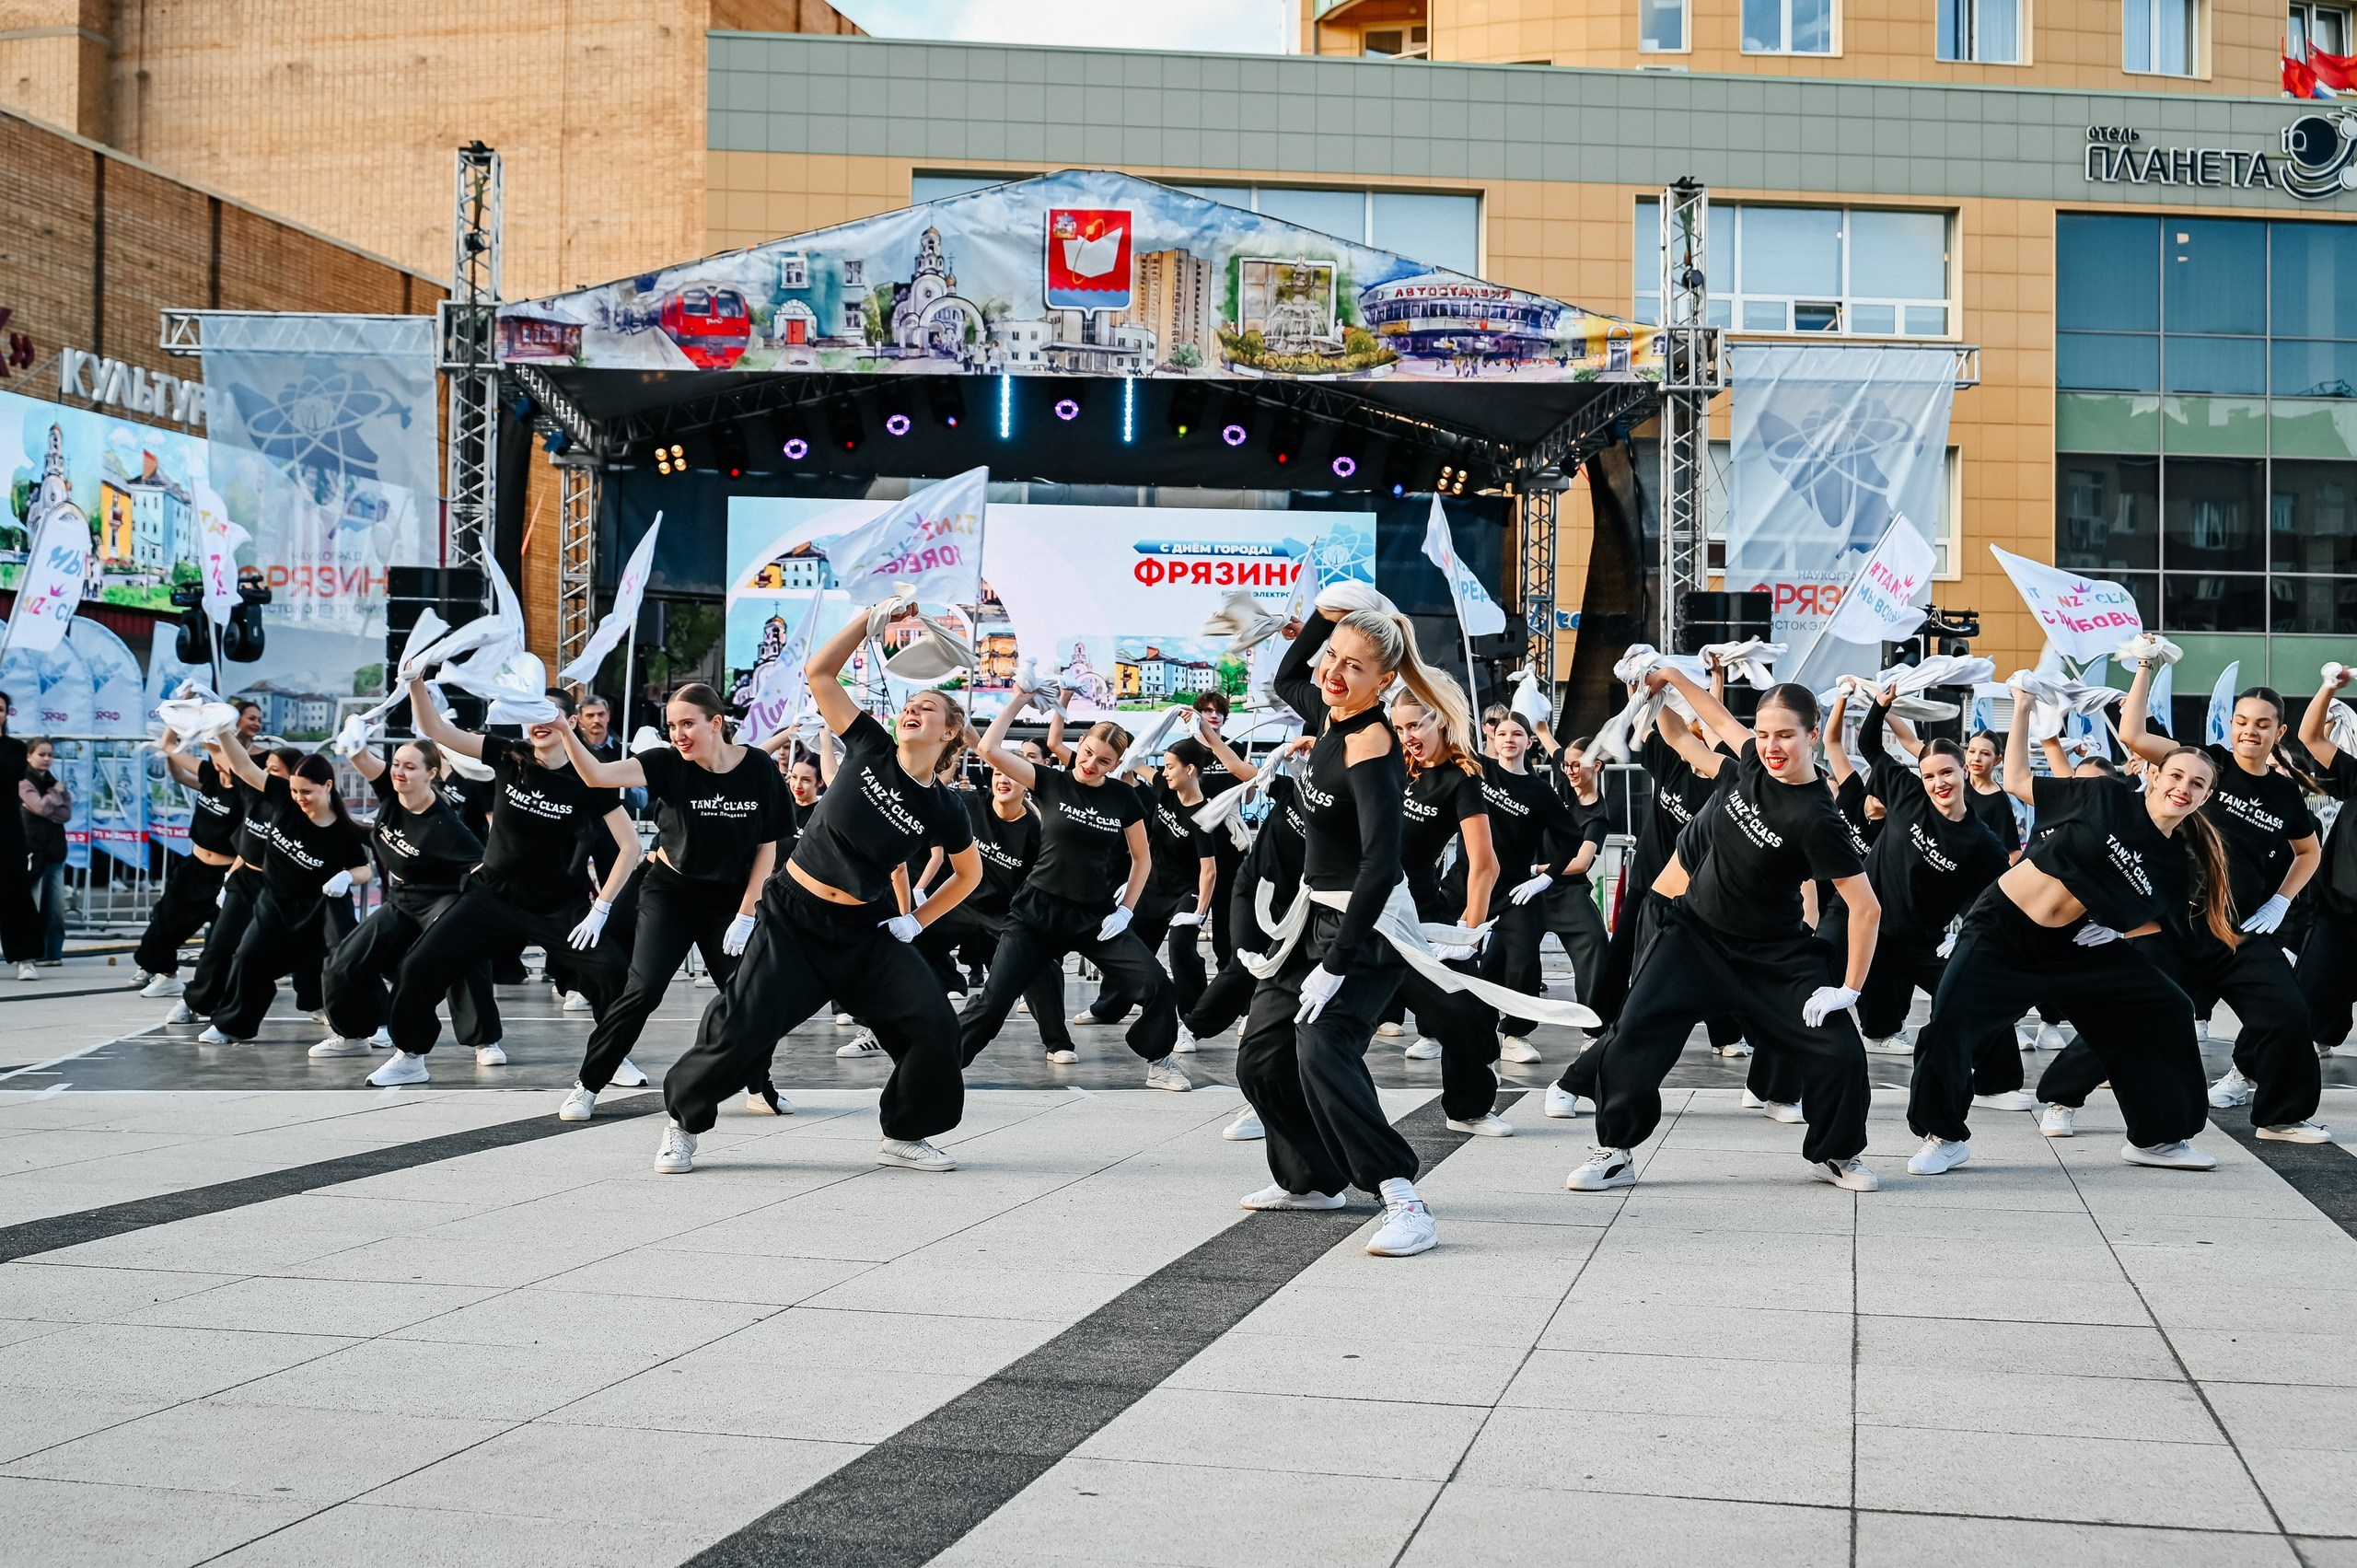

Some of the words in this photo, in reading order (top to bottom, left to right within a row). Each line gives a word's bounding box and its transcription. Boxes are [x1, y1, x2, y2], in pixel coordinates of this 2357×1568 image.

[2086, 125, 2140, 144] отель
[2084, 144, 2274, 189] ПЛАНЕТА
[1160, 543, 1168, 552] С
[1172, 542, 1211, 554] ДНЁМ
[1213, 545, 1273, 555] ГОРОДА!
[238, 564, 389, 598] РЯЗИН
[1797, 570, 1856, 581] НАУКОГРА
[505, 784, 532, 805] TANZ
[539, 800, 573, 814] CLASS
[690, 799, 718, 809] TANZ
[723, 801, 758, 810] CLASS
[860, 766, 888, 800] TANZ
[891, 804, 924, 834] CLASS
[1403, 798, 1438, 817] CLASS
[1504, 797, 1529, 815] CLASS
[1059, 802, 1086, 819] TANZ
[1674, 804, 1694, 821] CLAS
[1729, 789, 1749, 816] TANZ
[1749, 819, 1782, 847] CLASS
[2218, 791, 2248, 812] TANZ
[2254, 808, 2283, 830] CLASS
[271, 827, 293, 850] TANZ
[296, 850, 324, 867] CLASS
[2107, 833, 2131, 865] TANZ
[996, 852, 1023, 867] CLASS
[1929, 849, 1957, 871] CLASS
